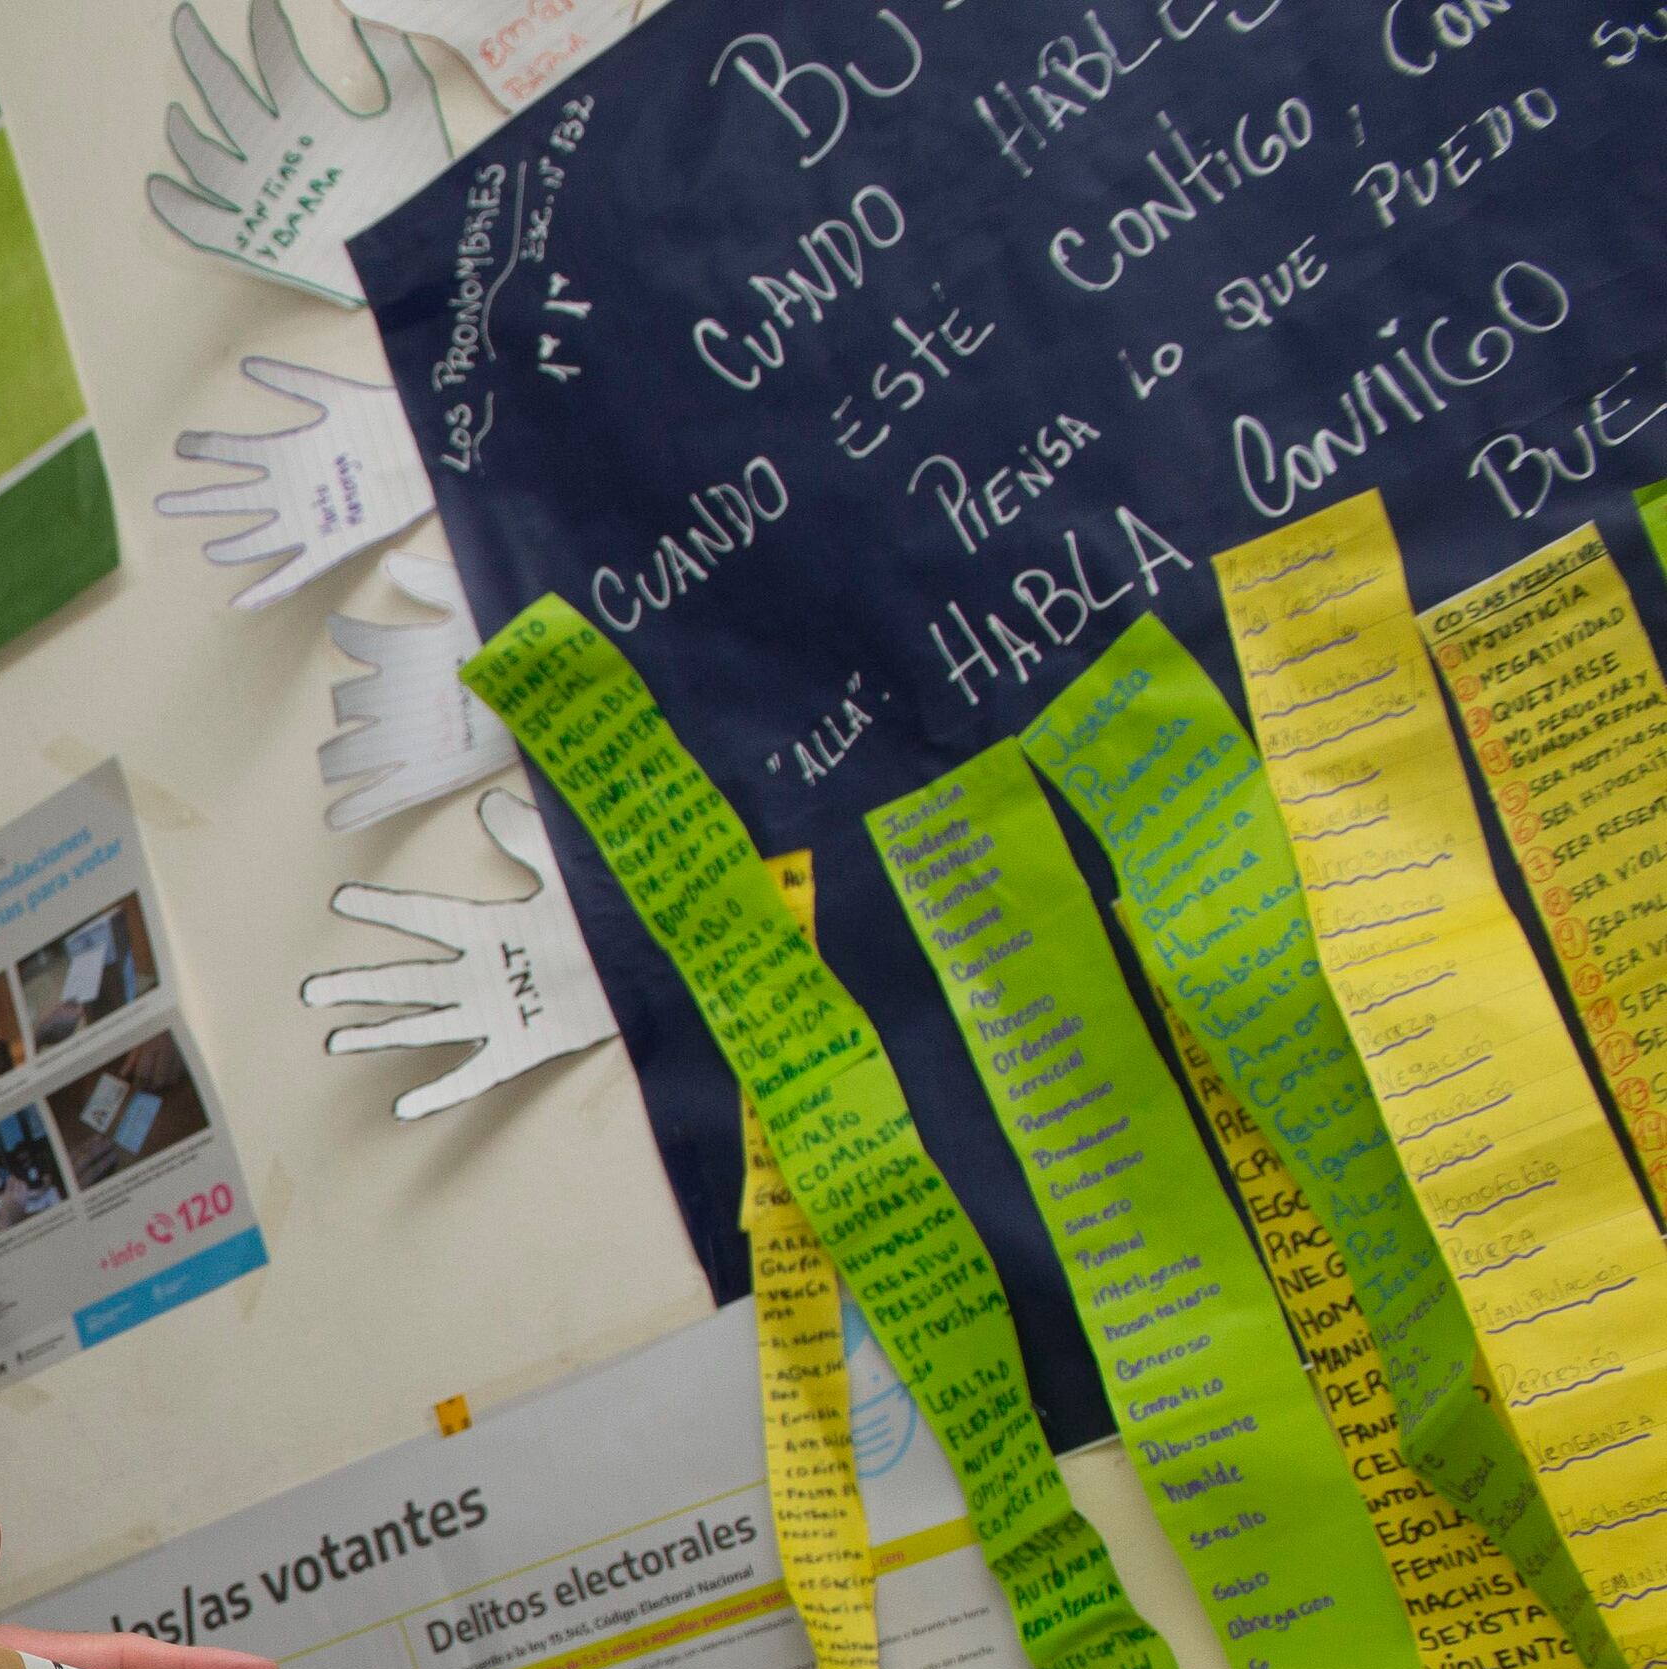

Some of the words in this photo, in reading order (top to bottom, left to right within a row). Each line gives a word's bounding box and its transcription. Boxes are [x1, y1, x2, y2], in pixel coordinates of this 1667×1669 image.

[431, 162, 507, 391] PRONOMBRES
[693, 185, 905, 391] CUANDO
[1116, 341, 1184, 399] LO
[1215, 235, 1329, 330] QUE
[1352, 87, 1558, 228] PUEDO
[439, 401, 474, 473] LOS
[591, 456, 788, 632] CUANDO
[929, 505, 1193, 705] HABLA
[472, 618, 547, 695] JUSTO
[498, 629, 597, 714] HONESTO
[173, 1181, 237, 1239] 120
[259, 1484, 490, 1604] votantes
[425, 1586, 547, 1656] Delitos
[553, 1511, 760, 1614] electorales
[637, 1582, 704, 1618] Electoral
[704, 1564, 755, 1597] Nacional
